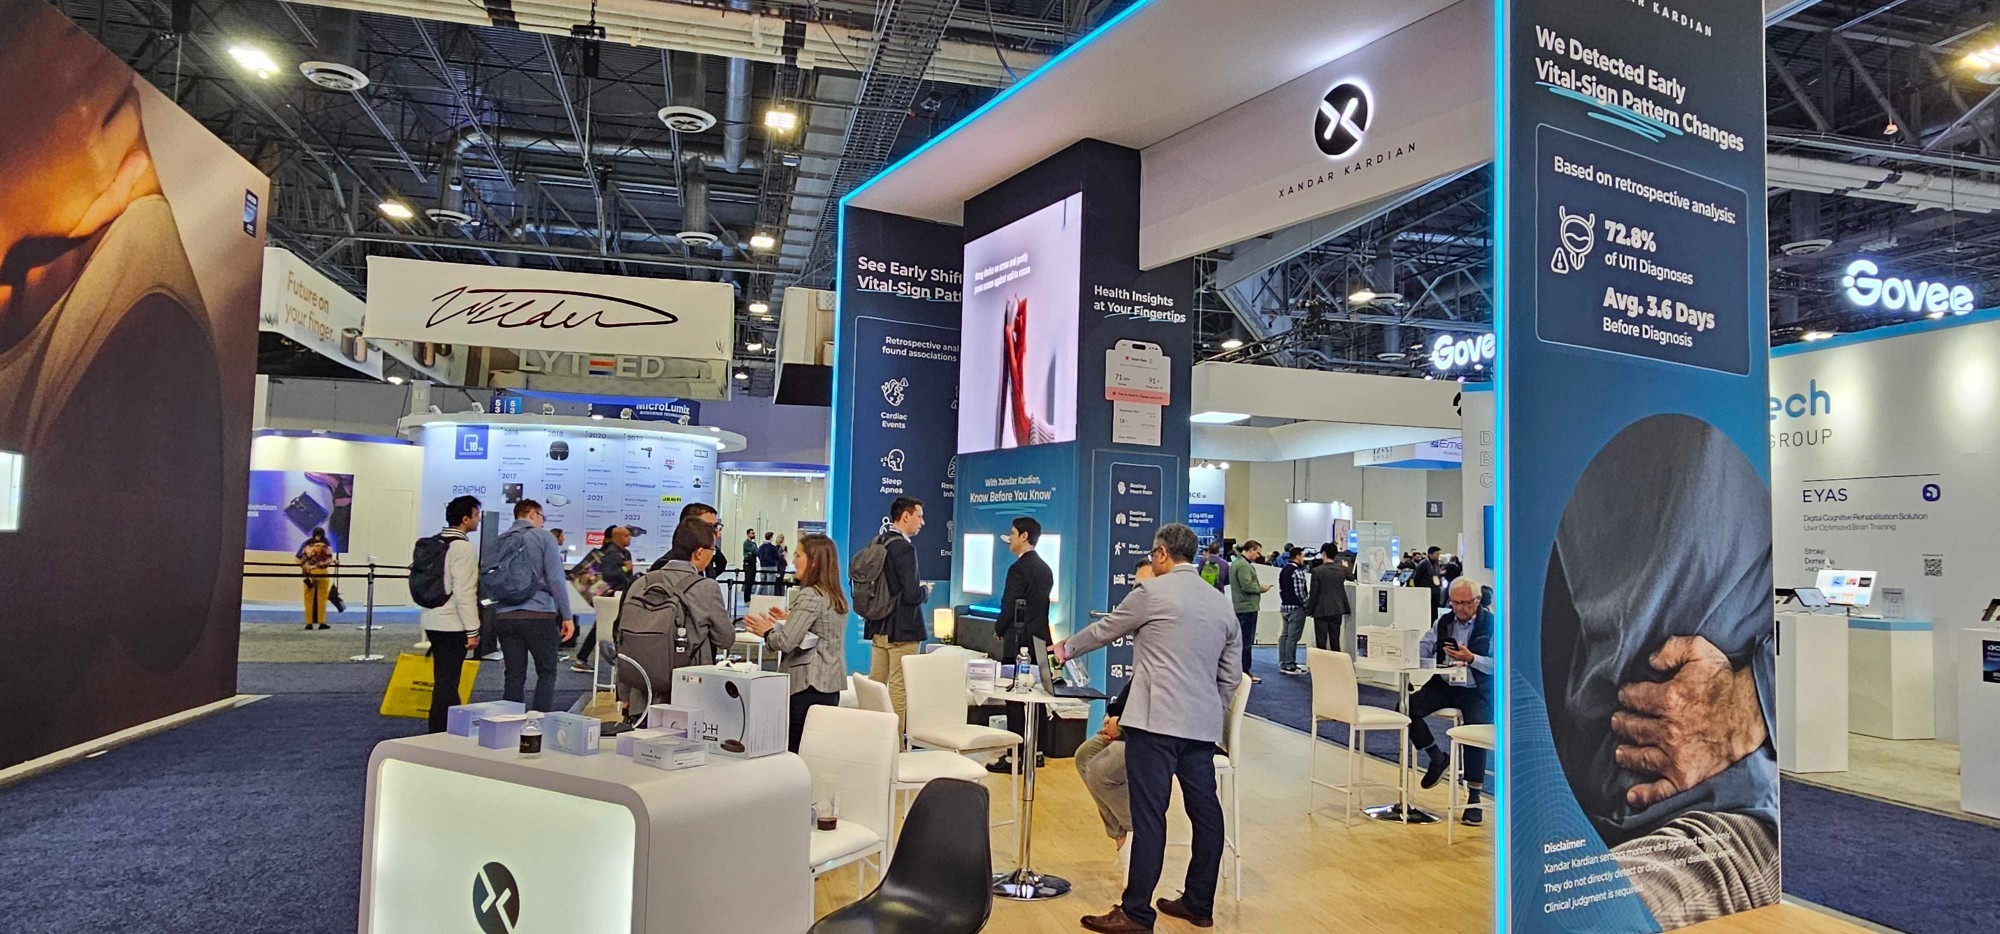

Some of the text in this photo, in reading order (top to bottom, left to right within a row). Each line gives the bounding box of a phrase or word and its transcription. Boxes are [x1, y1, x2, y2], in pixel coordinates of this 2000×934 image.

[1653, 2, 1712, 37] KARDIAN
[1535, 24, 1686, 104] We Detected Early
[1535, 57, 1744, 152] Vital-Sign Pattern Changes
[1278, 142, 1416, 198] XANDAR KARDIAN
[1554, 155, 1736, 224] Based on retrospective analysis:
[1604, 219, 1656, 252] 72.8%
[857, 255, 886, 273] See
[890, 261, 928, 281] Early
[1604, 252, 1694, 285] of UTI Diagnoses
[287, 270, 330, 315] Future on
[857, 275, 931, 299] Vital-Sign
[1094, 284, 1174, 306] Health Insights
[1842, 259, 1974, 316] Govee
[285, 303, 307, 324] your
[1093, 301, 1186, 323] at Your Fingertips
[1603, 287, 1716, 332] Avg. 3.6 Days
[885, 336, 941, 350] Retrospective
[1603, 317, 1693, 347] Before Diagnosis
[881, 345, 957, 362] found associations
[881, 411, 908, 420] Cardiac
[882, 420, 906, 429] Events
[452, 485, 487, 495] RENPHO
[880, 486, 903, 494] Apnea
[882, 477, 902, 486] Sleep
[985, 478, 998, 487] With
[970, 491, 989, 503] Know
[989, 490, 1013, 502] Before
[1014, 489, 1028, 501] You
[1802, 488, 1848, 503] EYAS
[1898, 512, 1928, 520] Solution
[1544, 839, 1586, 854] Disclaimer:
[1544, 861, 1571, 874] Xandar
[1571, 855, 1598, 868] Kardian
[1544, 883, 1562, 893] They
[1563, 879, 1573, 889] do
[1574, 876, 1587, 886] not
[1587, 871, 1613, 884] directly
[1544, 898, 1571, 913] Clinical
[1571, 892, 1607, 909] judgment
[1608, 889, 1613, 899] is
